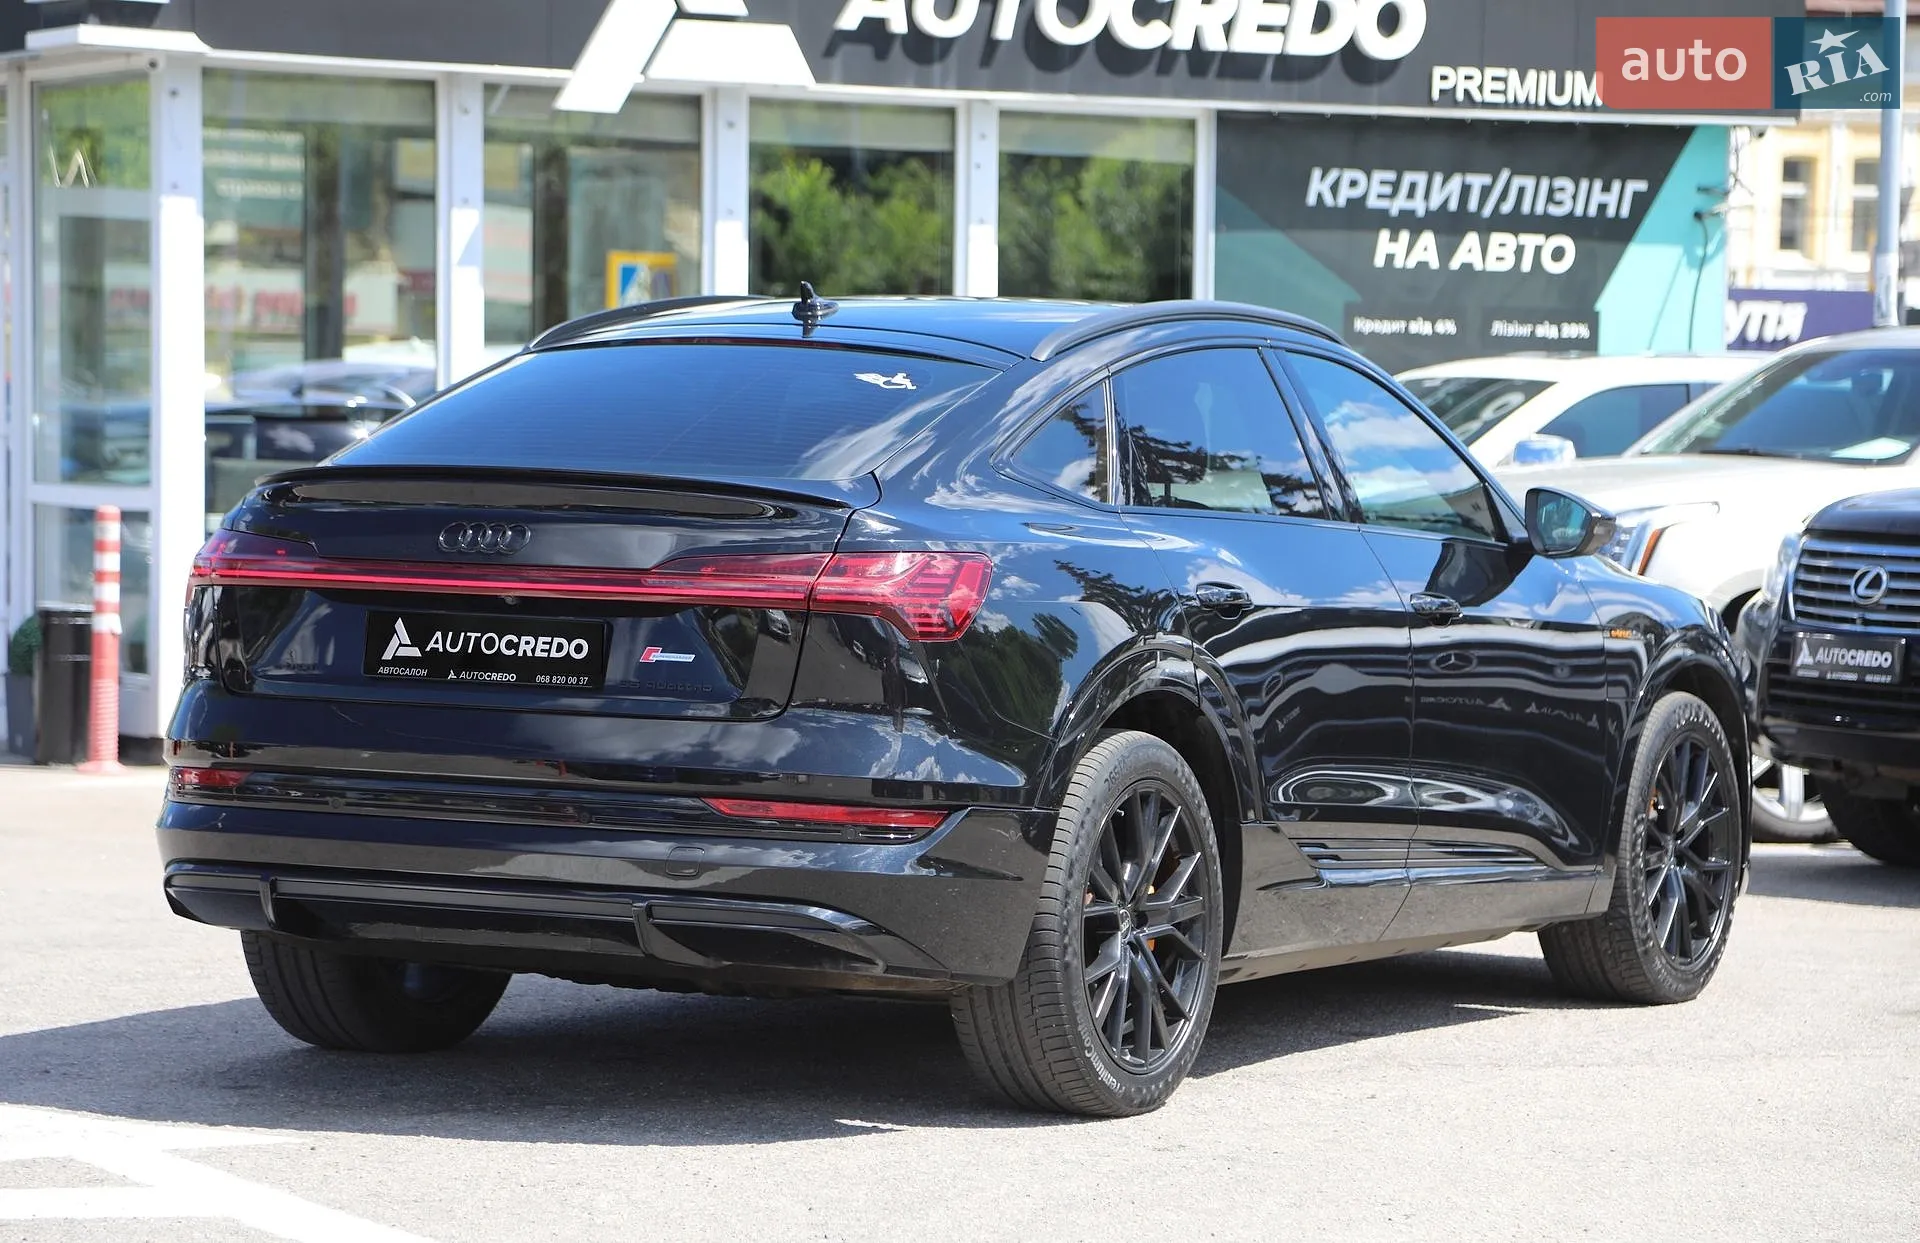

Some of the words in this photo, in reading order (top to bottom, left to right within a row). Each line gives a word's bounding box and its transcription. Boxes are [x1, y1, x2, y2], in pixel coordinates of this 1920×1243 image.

[1430, 65, 1604, 107] PREMIUM
[1305, 166, 1649, 219] КРЕДИТ/ЛІЗІНГ
[1373, 228, 1440, 270] НА
[1448, 230, 1577, 275] АВТО
[1353, 315, 1407, 336] Кредит
[425, 631, 589, 660] AUTOCREDO
[1815, 646, 1893, 669] AUTOCREDO
[377, 666, 428, 677] АВТОСАЛОН
[459, 671, 517, 682] AUTOCREDO
[535, 675, 550, 684] 068
[551, 675, 566, 684] 820
[567, 676, 577, 685] 00
[579, 676, 589, 685] 37
